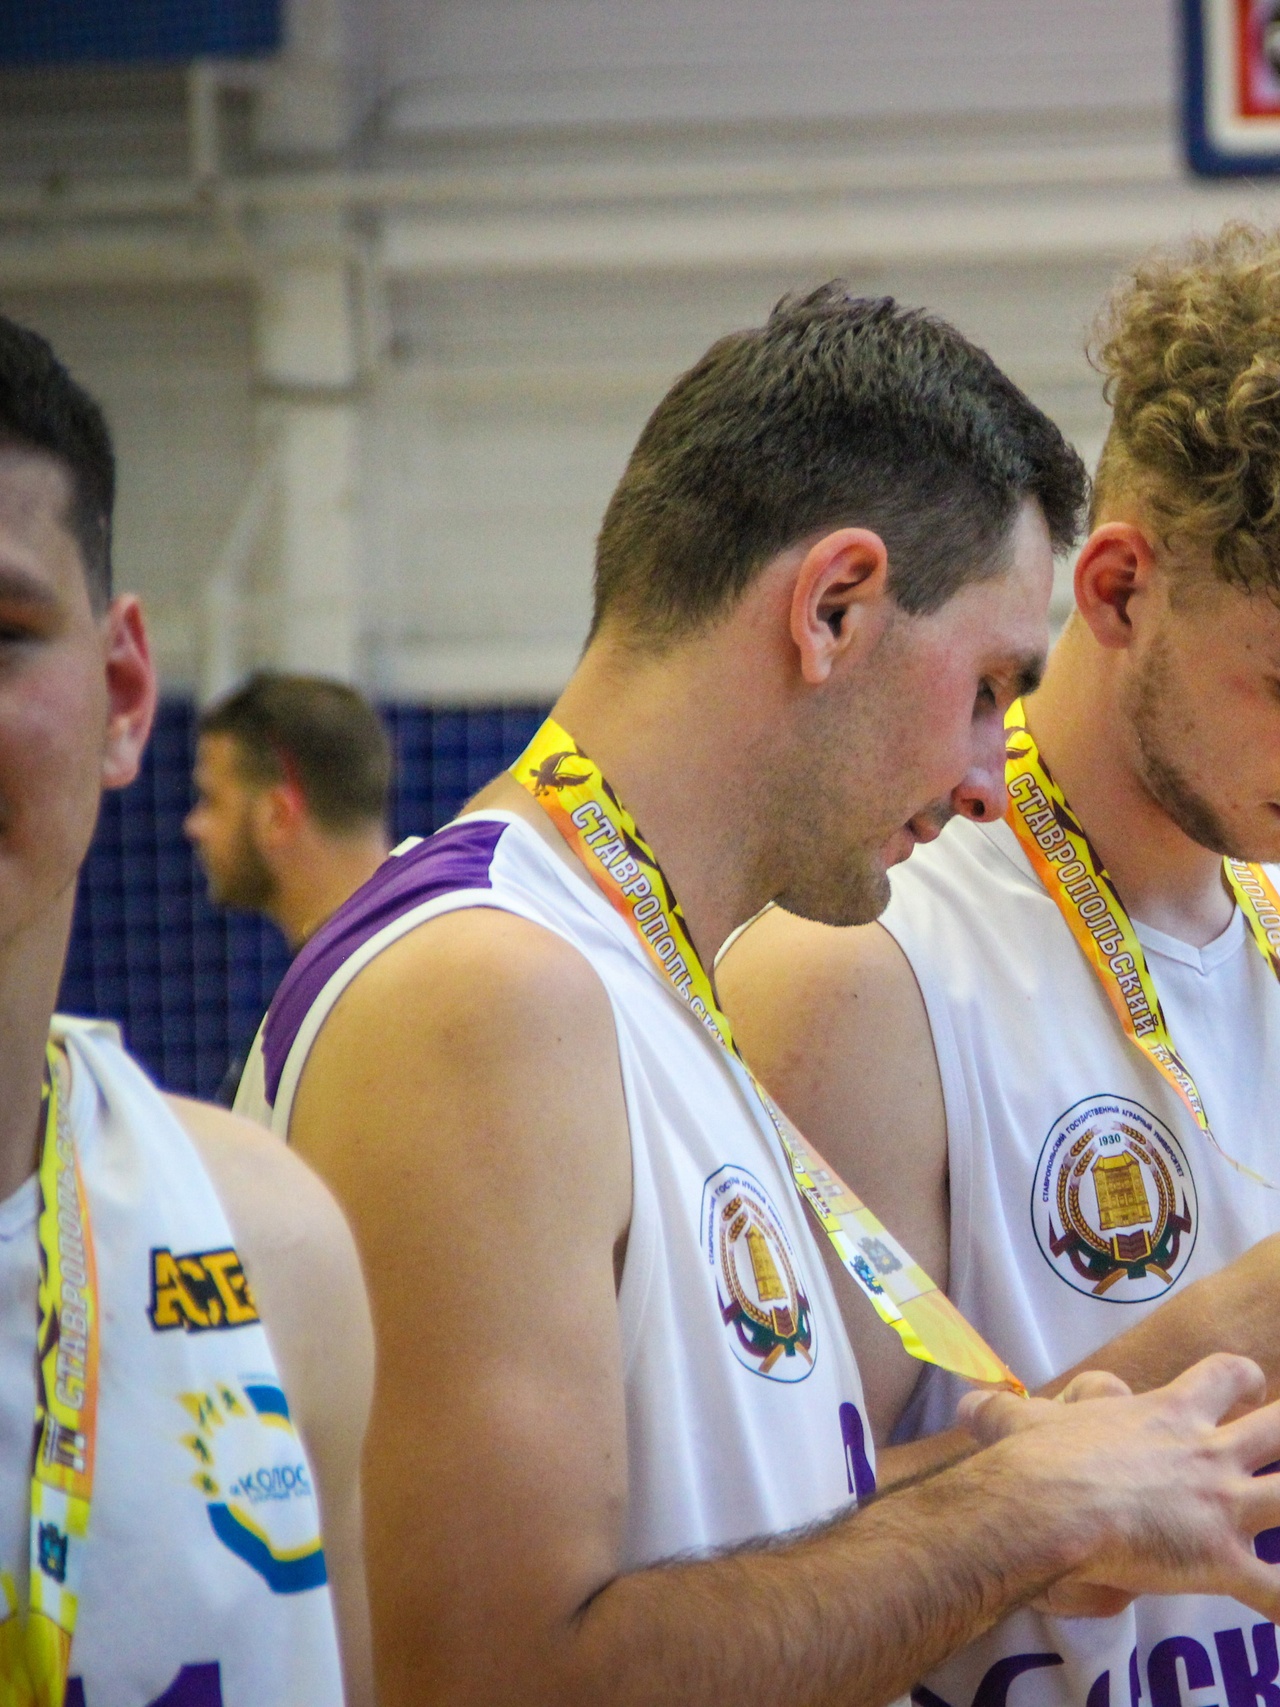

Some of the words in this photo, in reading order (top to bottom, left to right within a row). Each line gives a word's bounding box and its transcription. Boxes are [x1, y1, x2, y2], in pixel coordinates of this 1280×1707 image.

[569, 798, 728, 1048] СТАВРОПОЛЬСК
[1006, 771, 1159, 1040] СТАВРОПОЛЬСКИЙ
[1042, 1133, 1068, 1203] СТАВРОПОЛЬСКИЙ
[1122, 1109, 1153, 1133] АГРАРНЫЙ
[1098, 1133, 1122, 1147] 1930
